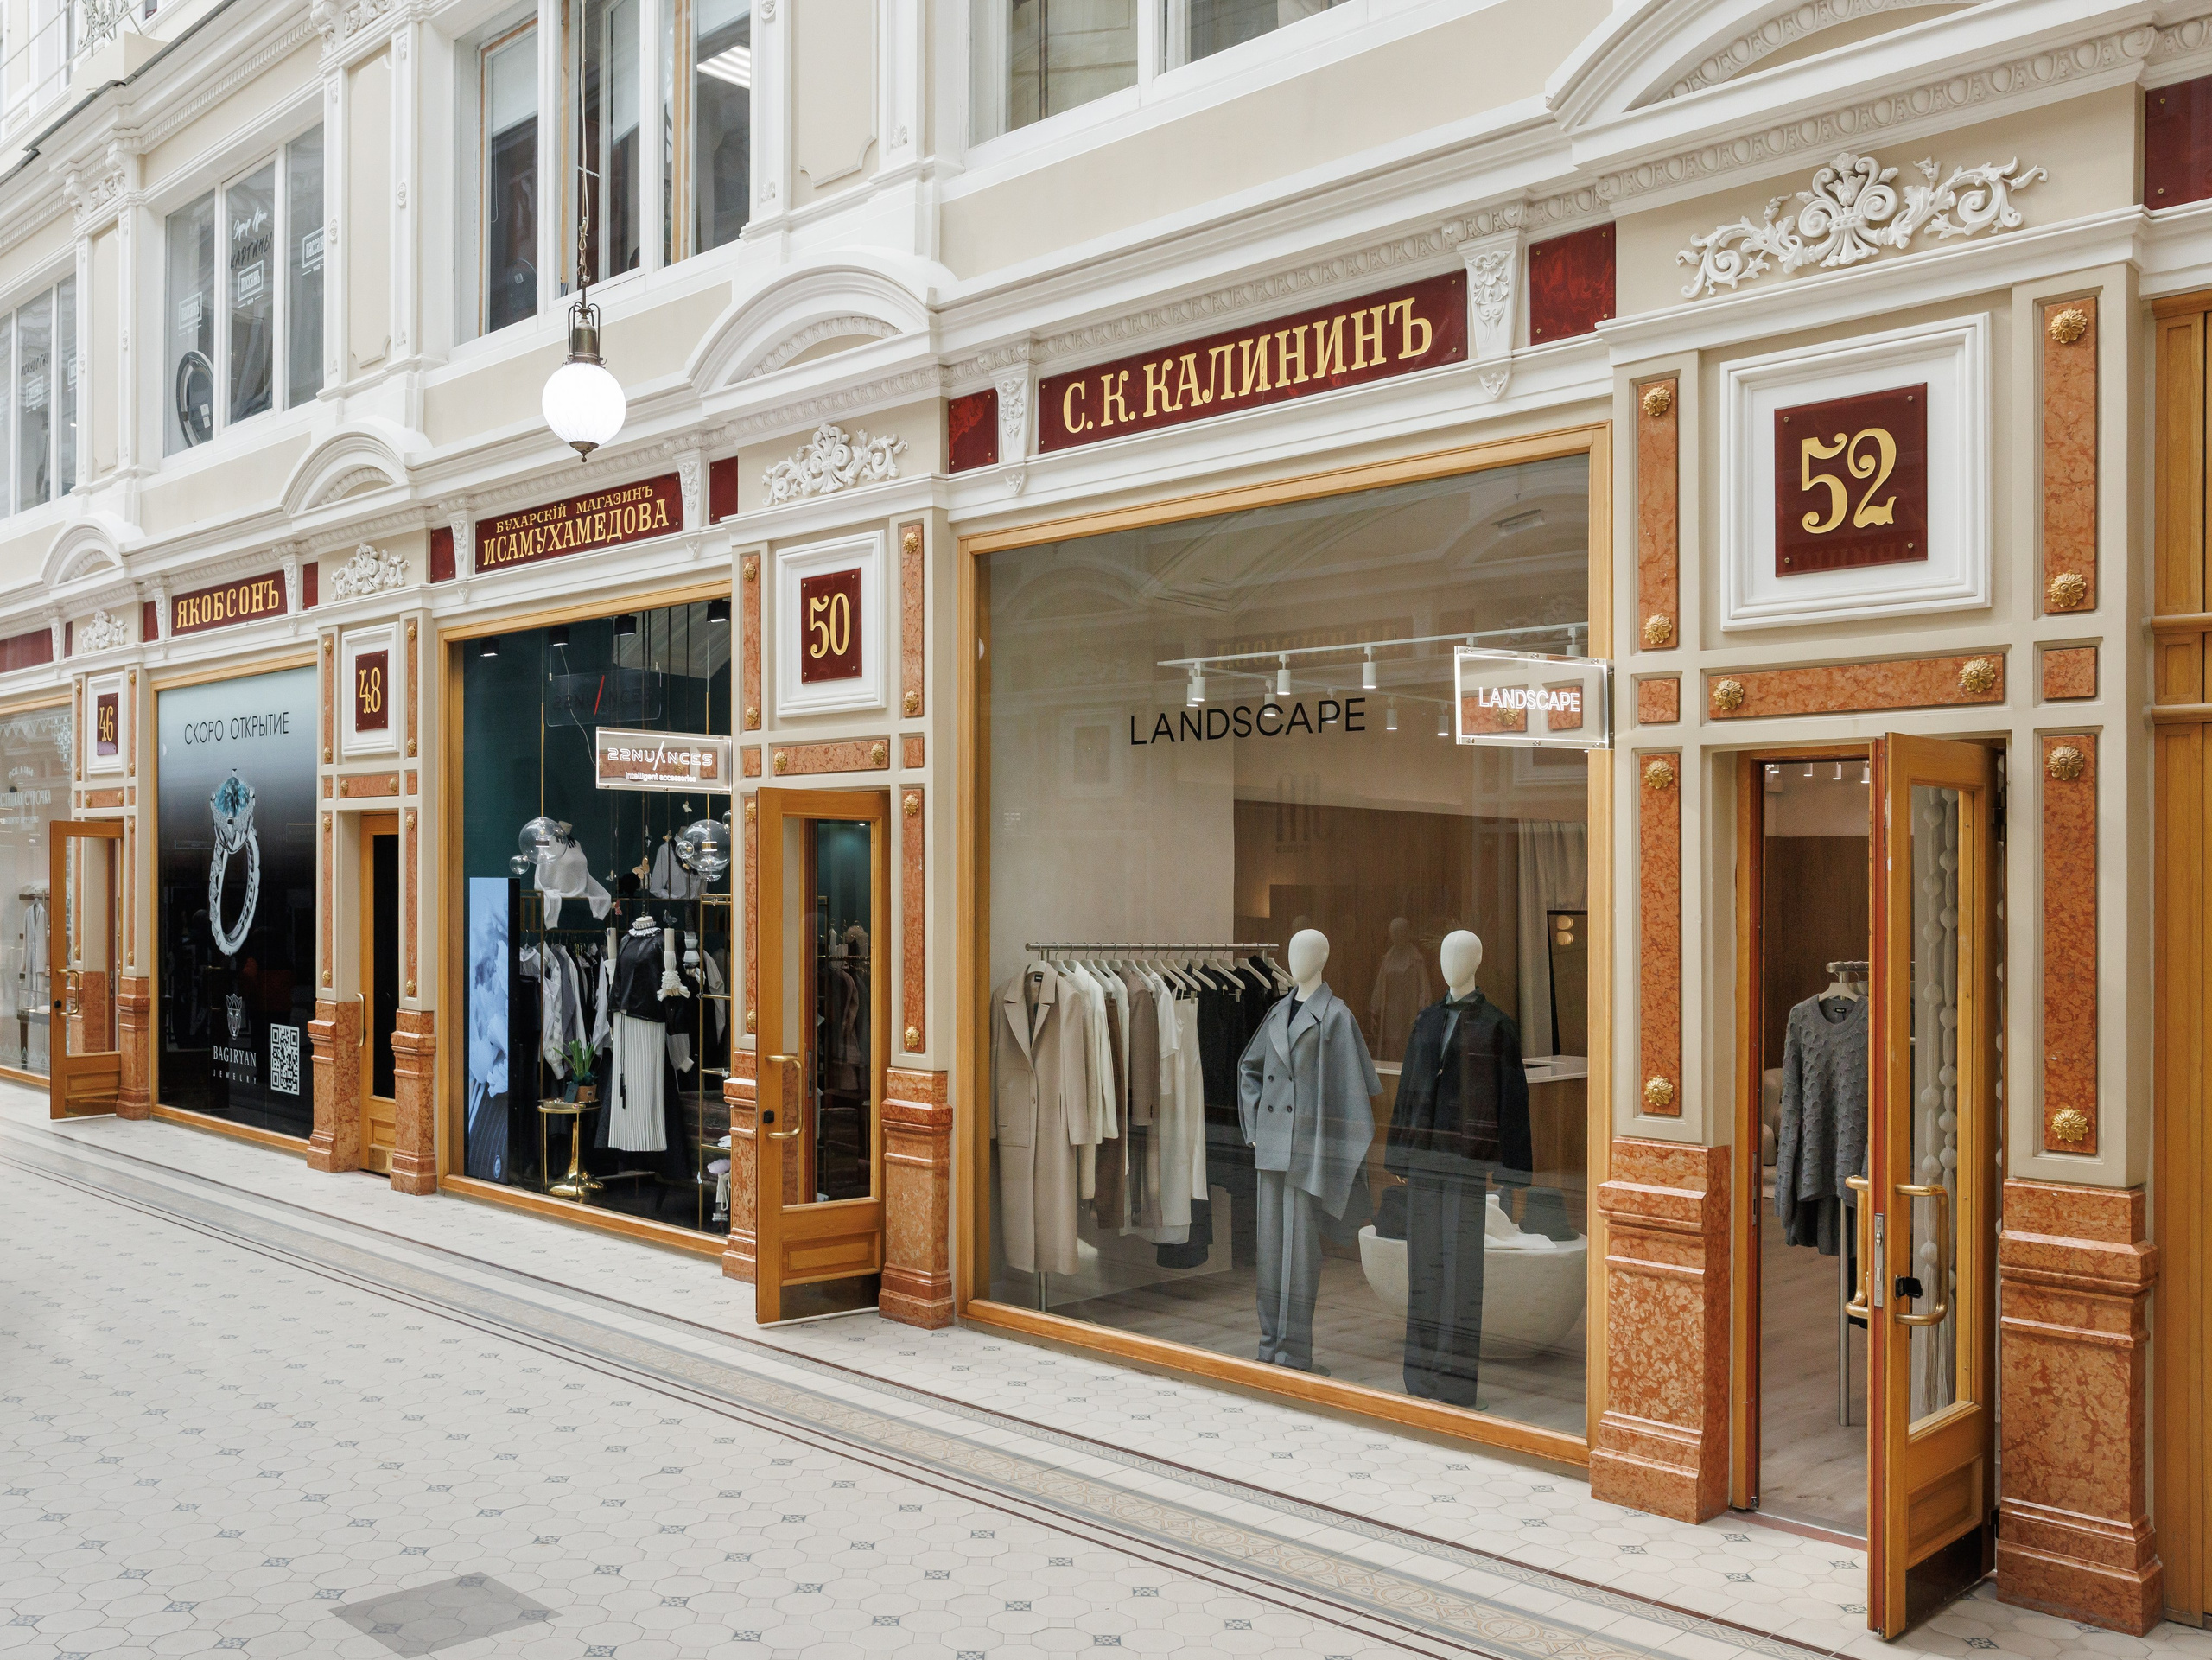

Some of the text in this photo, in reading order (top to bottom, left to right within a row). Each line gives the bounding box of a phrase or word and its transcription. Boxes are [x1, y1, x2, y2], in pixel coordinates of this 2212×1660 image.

[1802, 428, 1897, 534] 52
[576, 485, 653, 515] МАГАЗИНЪ
[483, 499, 670, 565] ИСАМУХАМЕДОВА
[176, 579, 279, 629] ЯКОБСОНЪ
[810, 592, 851, 658] 50
[359, 666, 381, 715] 48
[1478, 686, 1580, 713] LANDSCAPE
[99, 705, 114, 742] 46
[184, 711, 289, 745] СКОРО ОТКРЫТИЕ
[1130, 697, 1366, 745] LANDSCAPE
[659, 773, 696, 783] accessories
[213, 1045, 257, 1067] BAGIRYAN
[213, 1069, 257, 1084] JEWELRY
